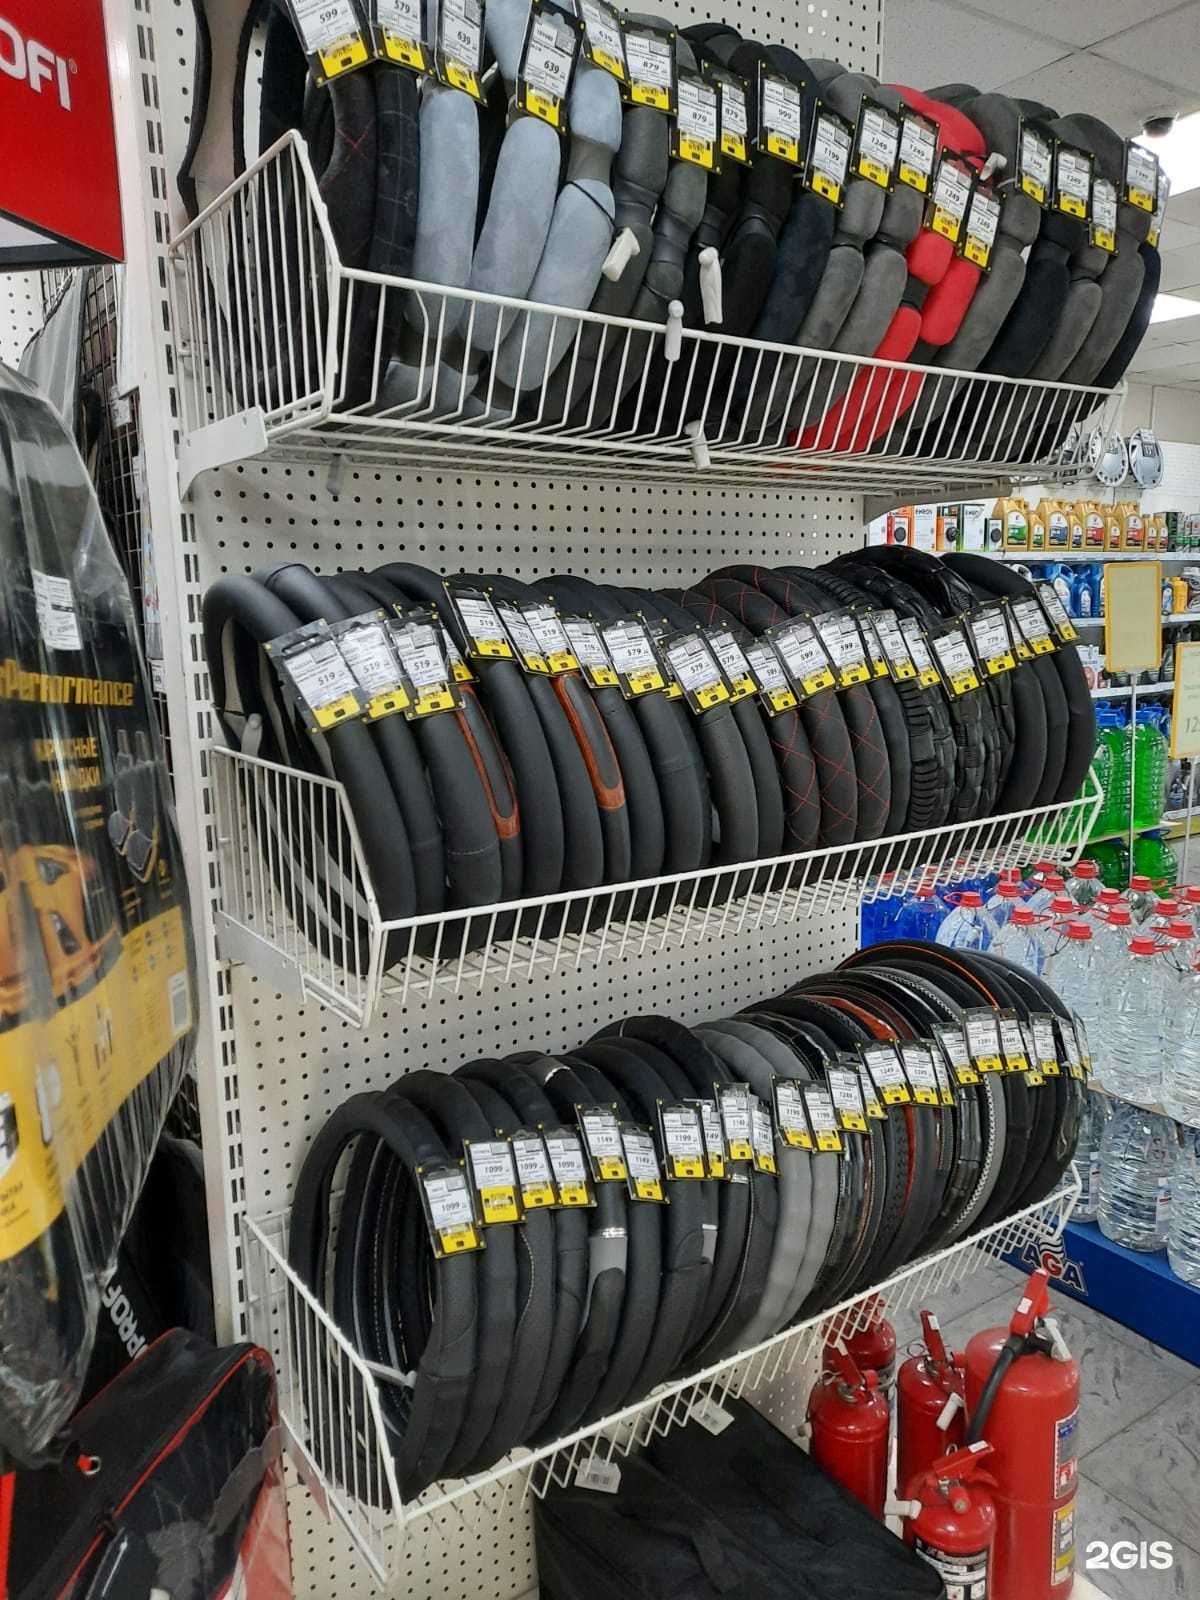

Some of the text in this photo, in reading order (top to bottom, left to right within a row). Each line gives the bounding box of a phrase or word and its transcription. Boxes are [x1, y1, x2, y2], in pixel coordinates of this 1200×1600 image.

[394, 0, 410, 14] 579
[319, 8, 339, 24] 599
[457, 31, 471, 45] 639
[543, 60, 560, 74] 639
[643, 58, 660, 71] 879
[692, 112, 707, 123] 879
[725, 108, 738, 119] 879
[870, 137, 888, 151] 1249
[824, 146, 840, 161] 1199
[909, 143, 925, 157] 1249
[944, 188, 960, 202] 1249
[976, 217, 990, 229] 1249
[479, 619, 494, 628] 519
[543, 628, 557, 637] 519
[840, 643, 853, 651] 599
[627, 649, 641, 657] 579
[414, 660, 430, 671] 519
[721, 655, 735, 666] 579
[363, 662, 380, 674] 519
[690, 663, 703, 674] 579
[318, 672, 335, 686] 519
[674, 1135, 691, 1143] 1199
[558, 1160, 575, 1168] 1099
[635, 1156, 650, 1164] 1149
[485, 1165, 503, 1175] 1099
[520, 1162, 537, 1170] 1099
[441, 1202, 460, 1213] 1099
[1022, 1241, 1086, 1293] AGA
